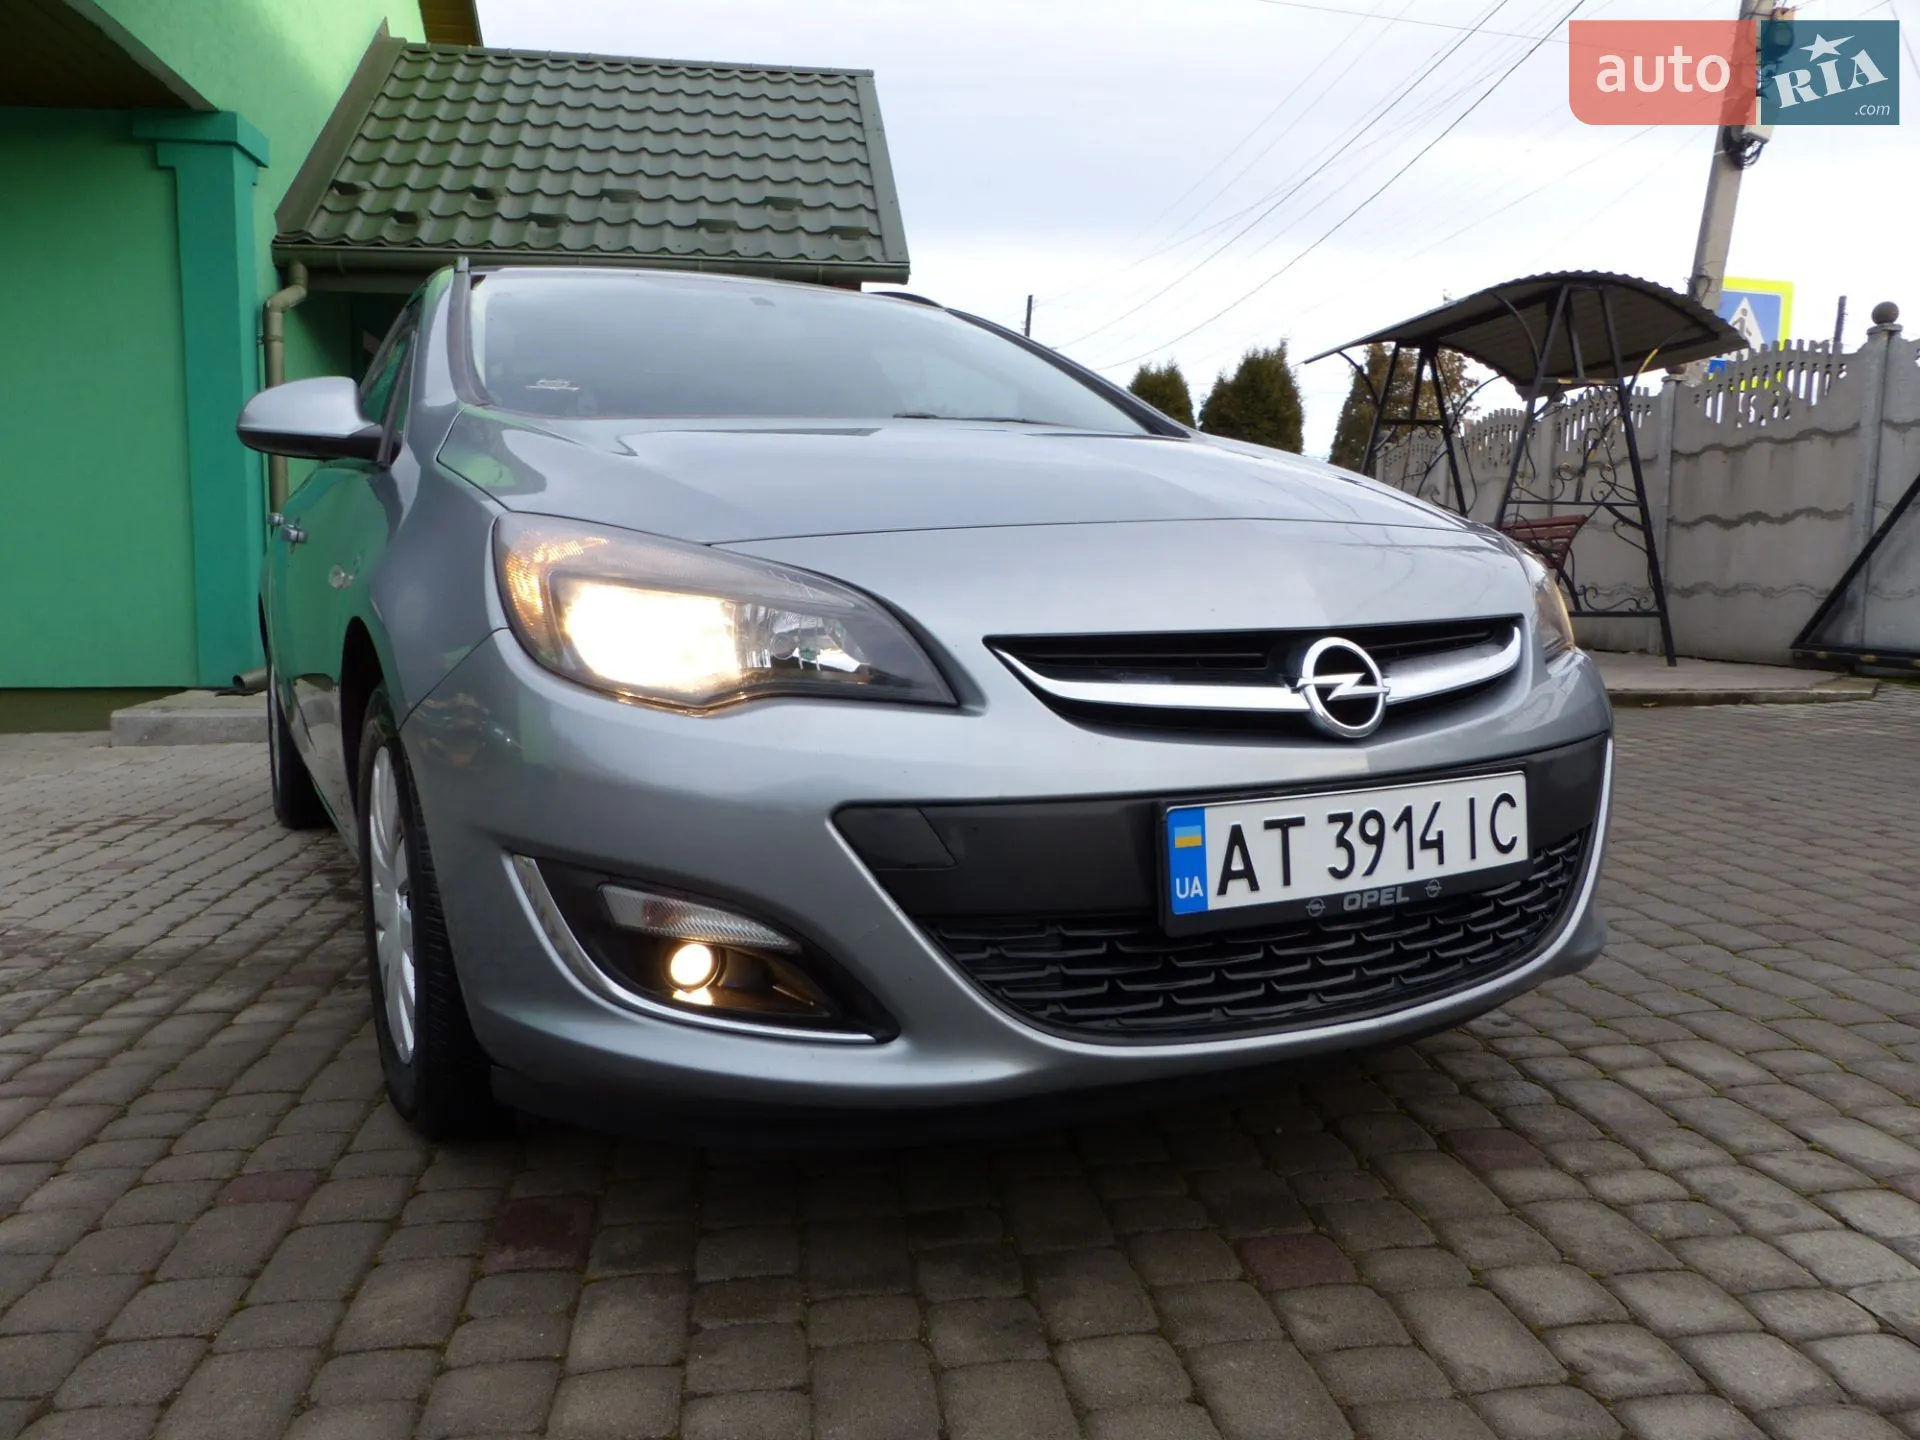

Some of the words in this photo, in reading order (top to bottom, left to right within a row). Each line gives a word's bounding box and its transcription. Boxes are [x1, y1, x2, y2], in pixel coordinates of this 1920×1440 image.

[1216, 815, 1305, 896] AT
[1327, 801, 1445, 879] 3914
[1468, 792, 1518, 861] IC
[1175, 875, 1204, 900] UA
[1342, 886, 1410, 912] OPEL
